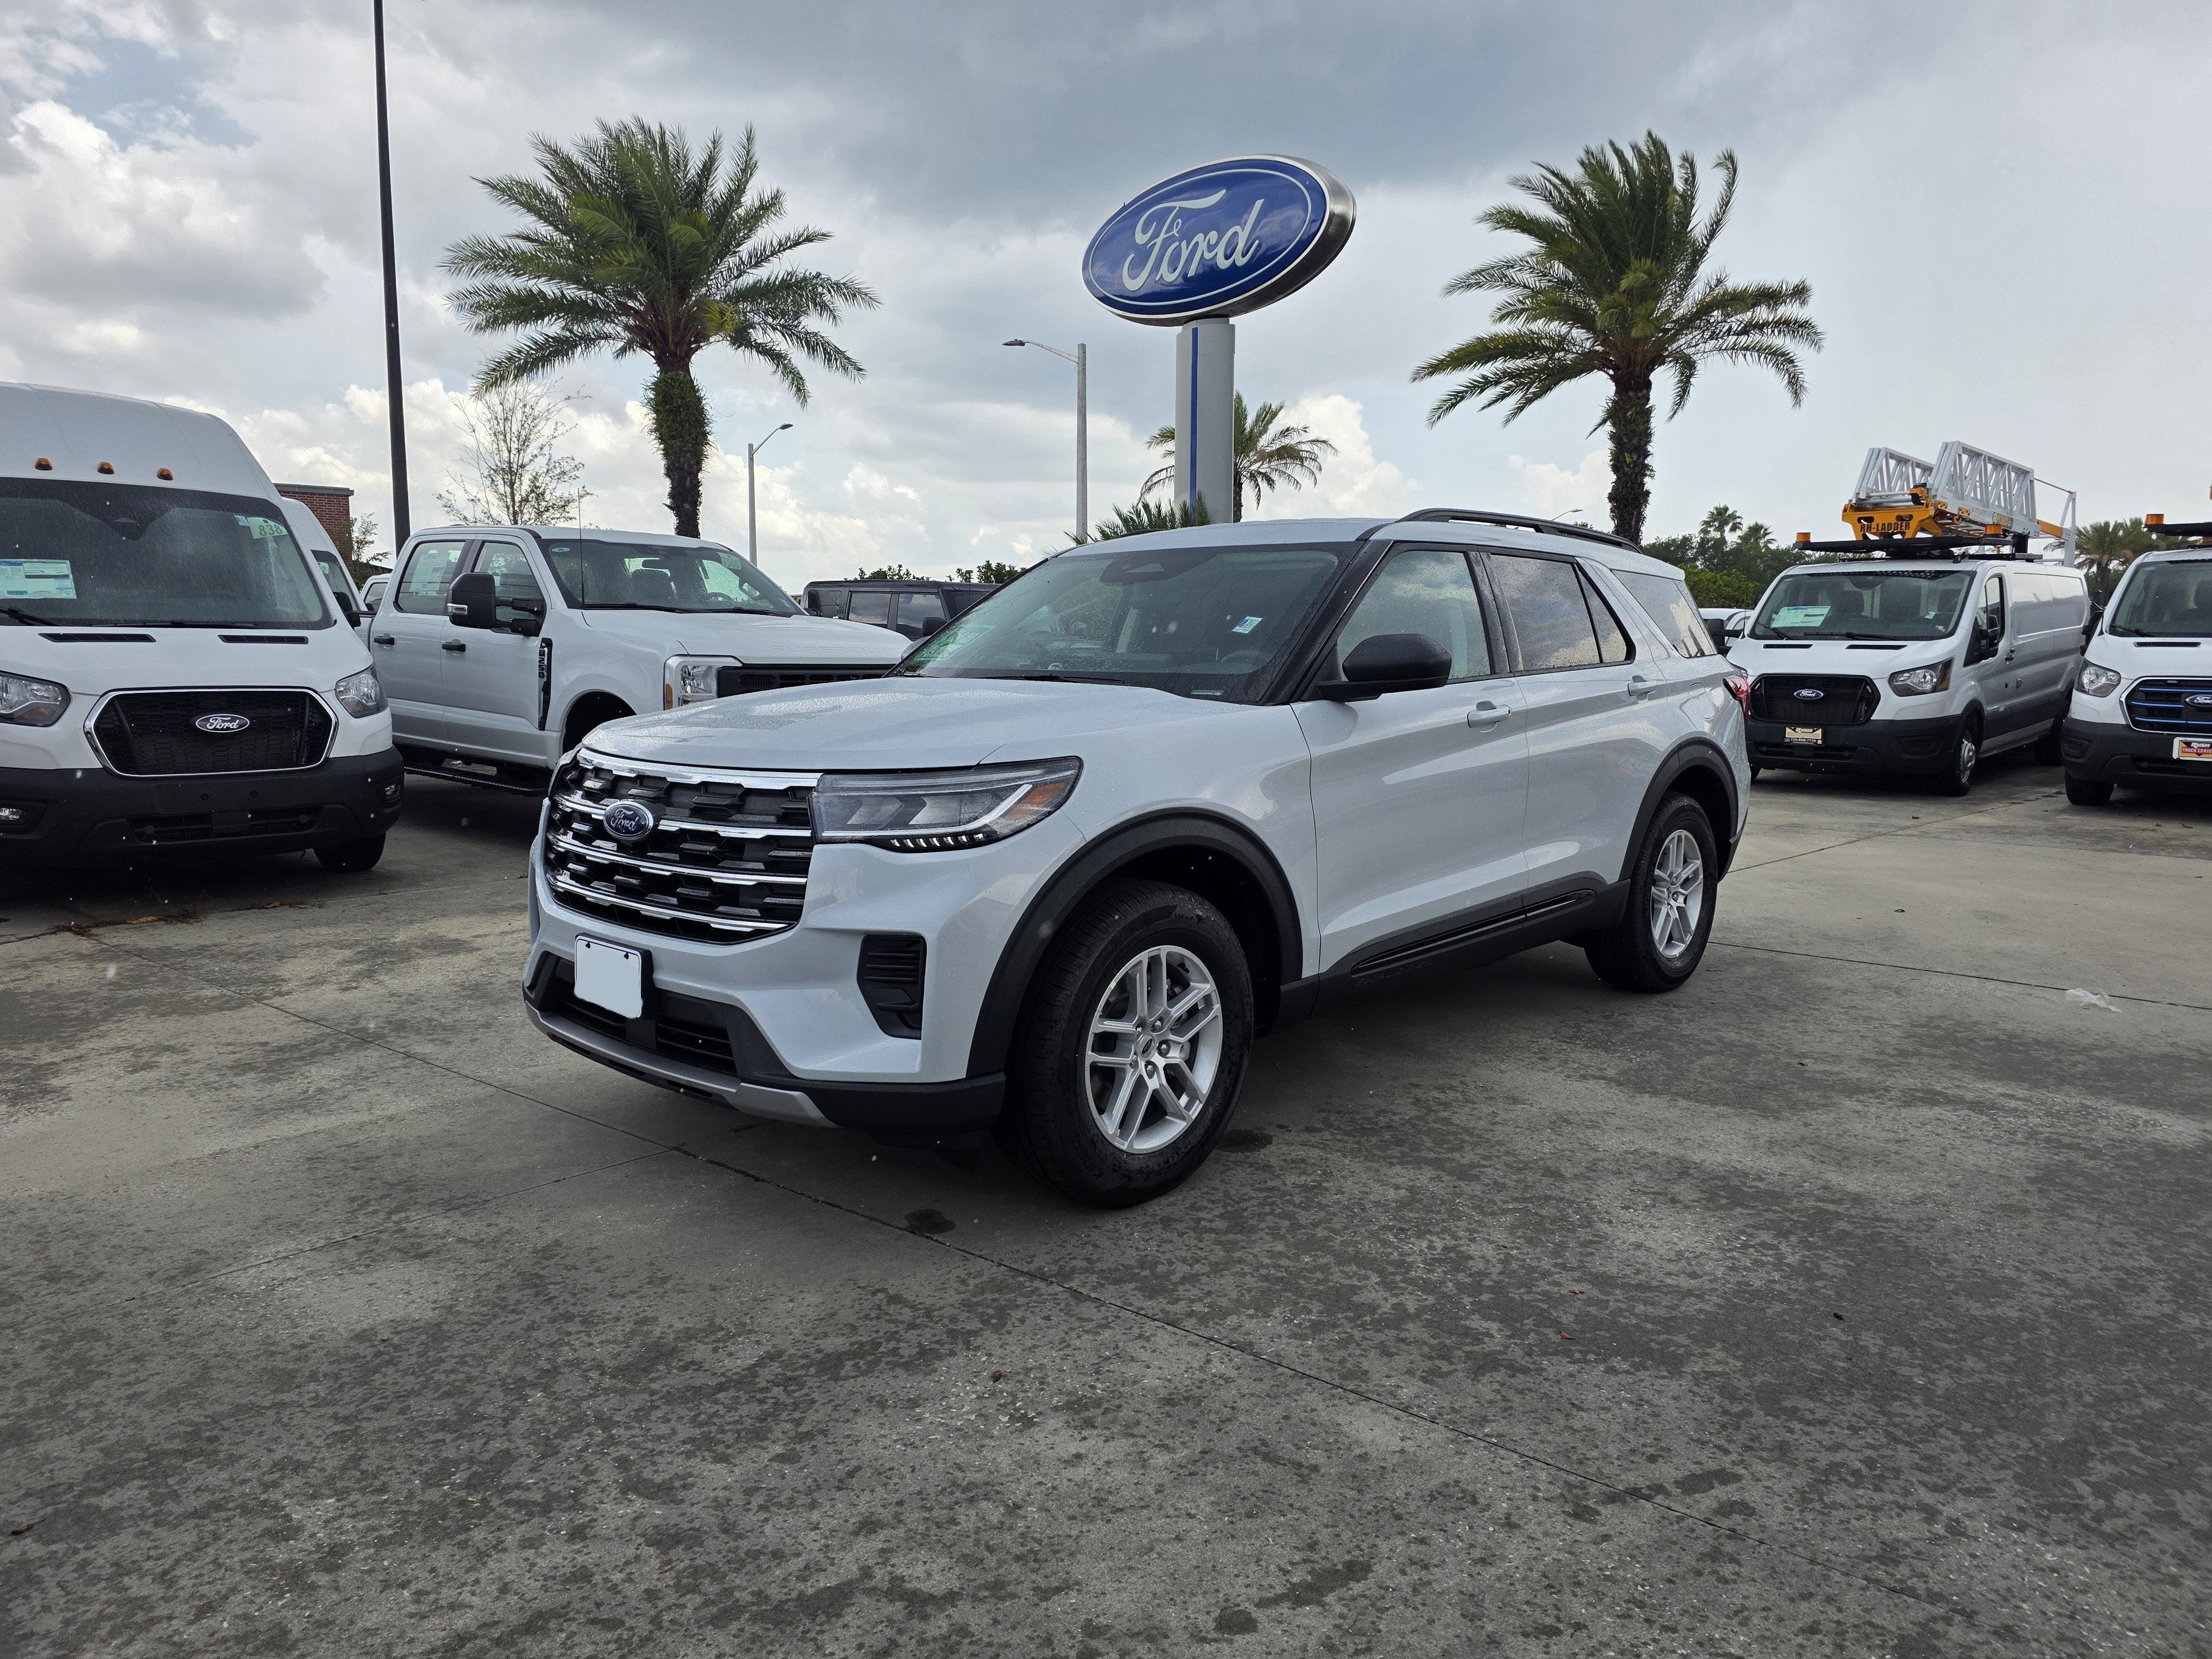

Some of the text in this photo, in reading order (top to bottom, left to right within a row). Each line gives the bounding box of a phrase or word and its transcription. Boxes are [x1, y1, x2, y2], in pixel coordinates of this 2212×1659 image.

[1121, 189, 1265, 292] Ford
[258, 524, 283, 537] 838
[1860, 522, 1911, 532] RH-LADDER
[768, 645, 848, 654] SUPER
[206, 717, 239, 729] Ford
[610, 808, 639, 831] Ford
